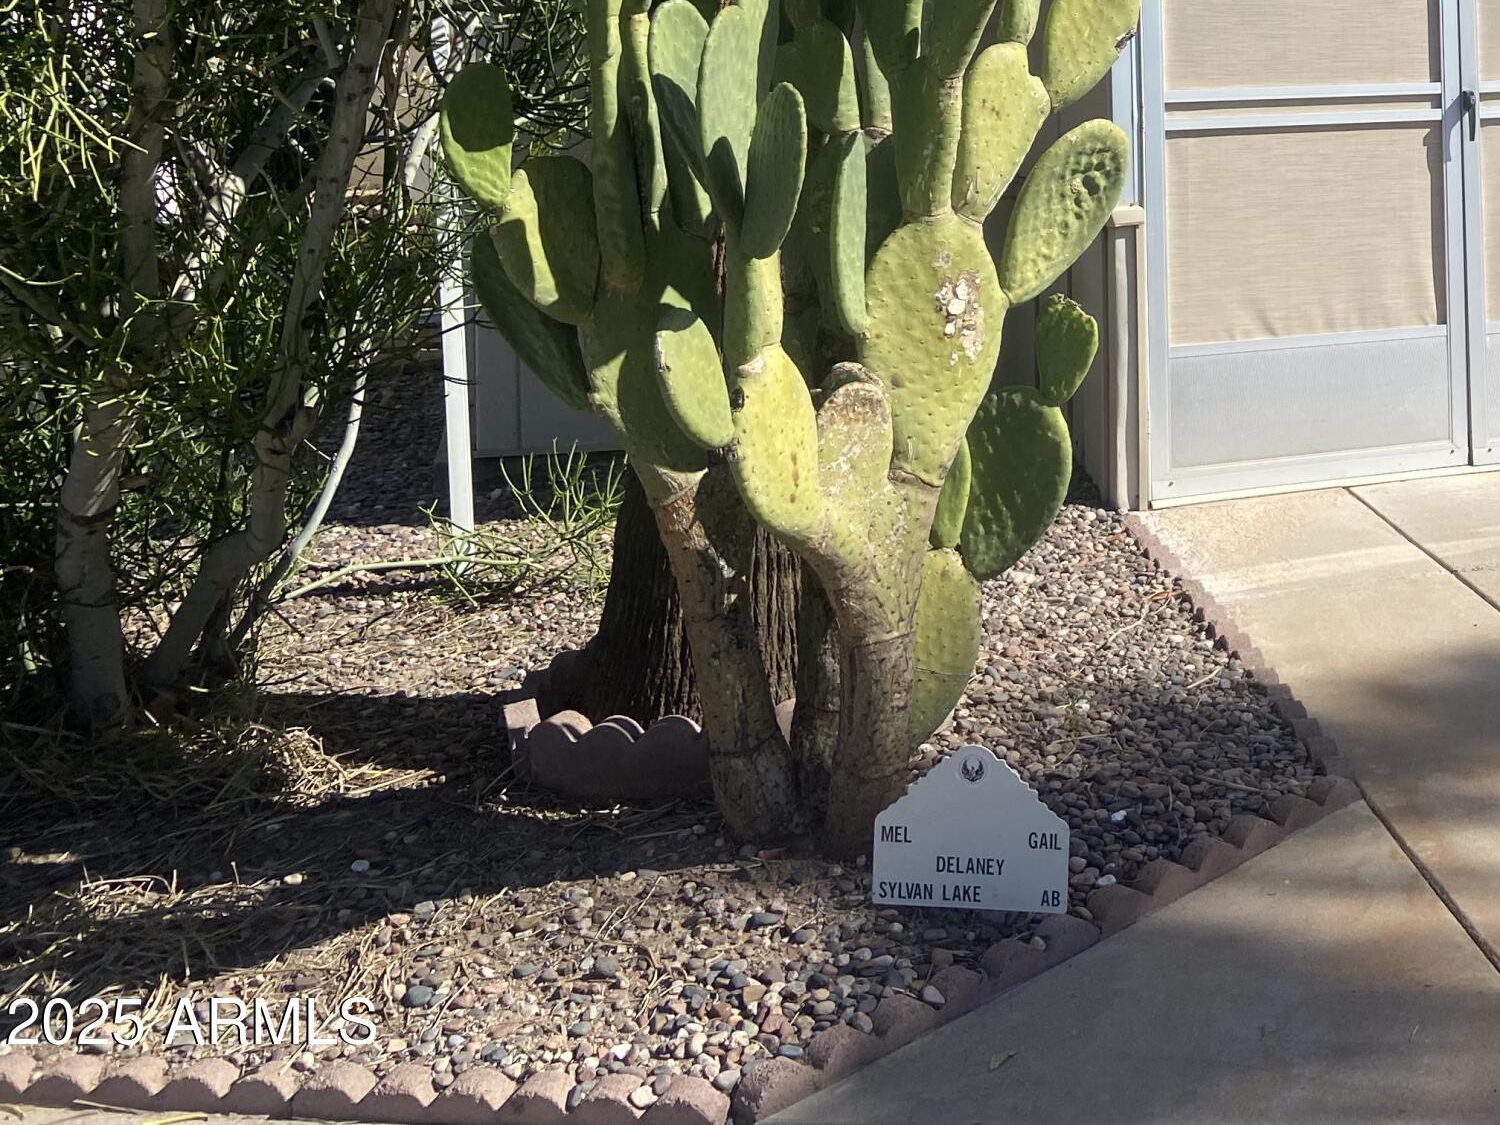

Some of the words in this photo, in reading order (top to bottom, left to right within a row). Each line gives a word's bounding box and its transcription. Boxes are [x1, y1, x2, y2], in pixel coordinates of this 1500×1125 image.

[880, 825, 912, 843] MEL
[1028, 832, 1062, 850] GAIL
[936, 856, 1005, 875] DELANEY
[879, 881, 933, 900] SYLVAN
[942, 884, 982, 902] LAKE
[1040, 890, 1061, 907] AB
